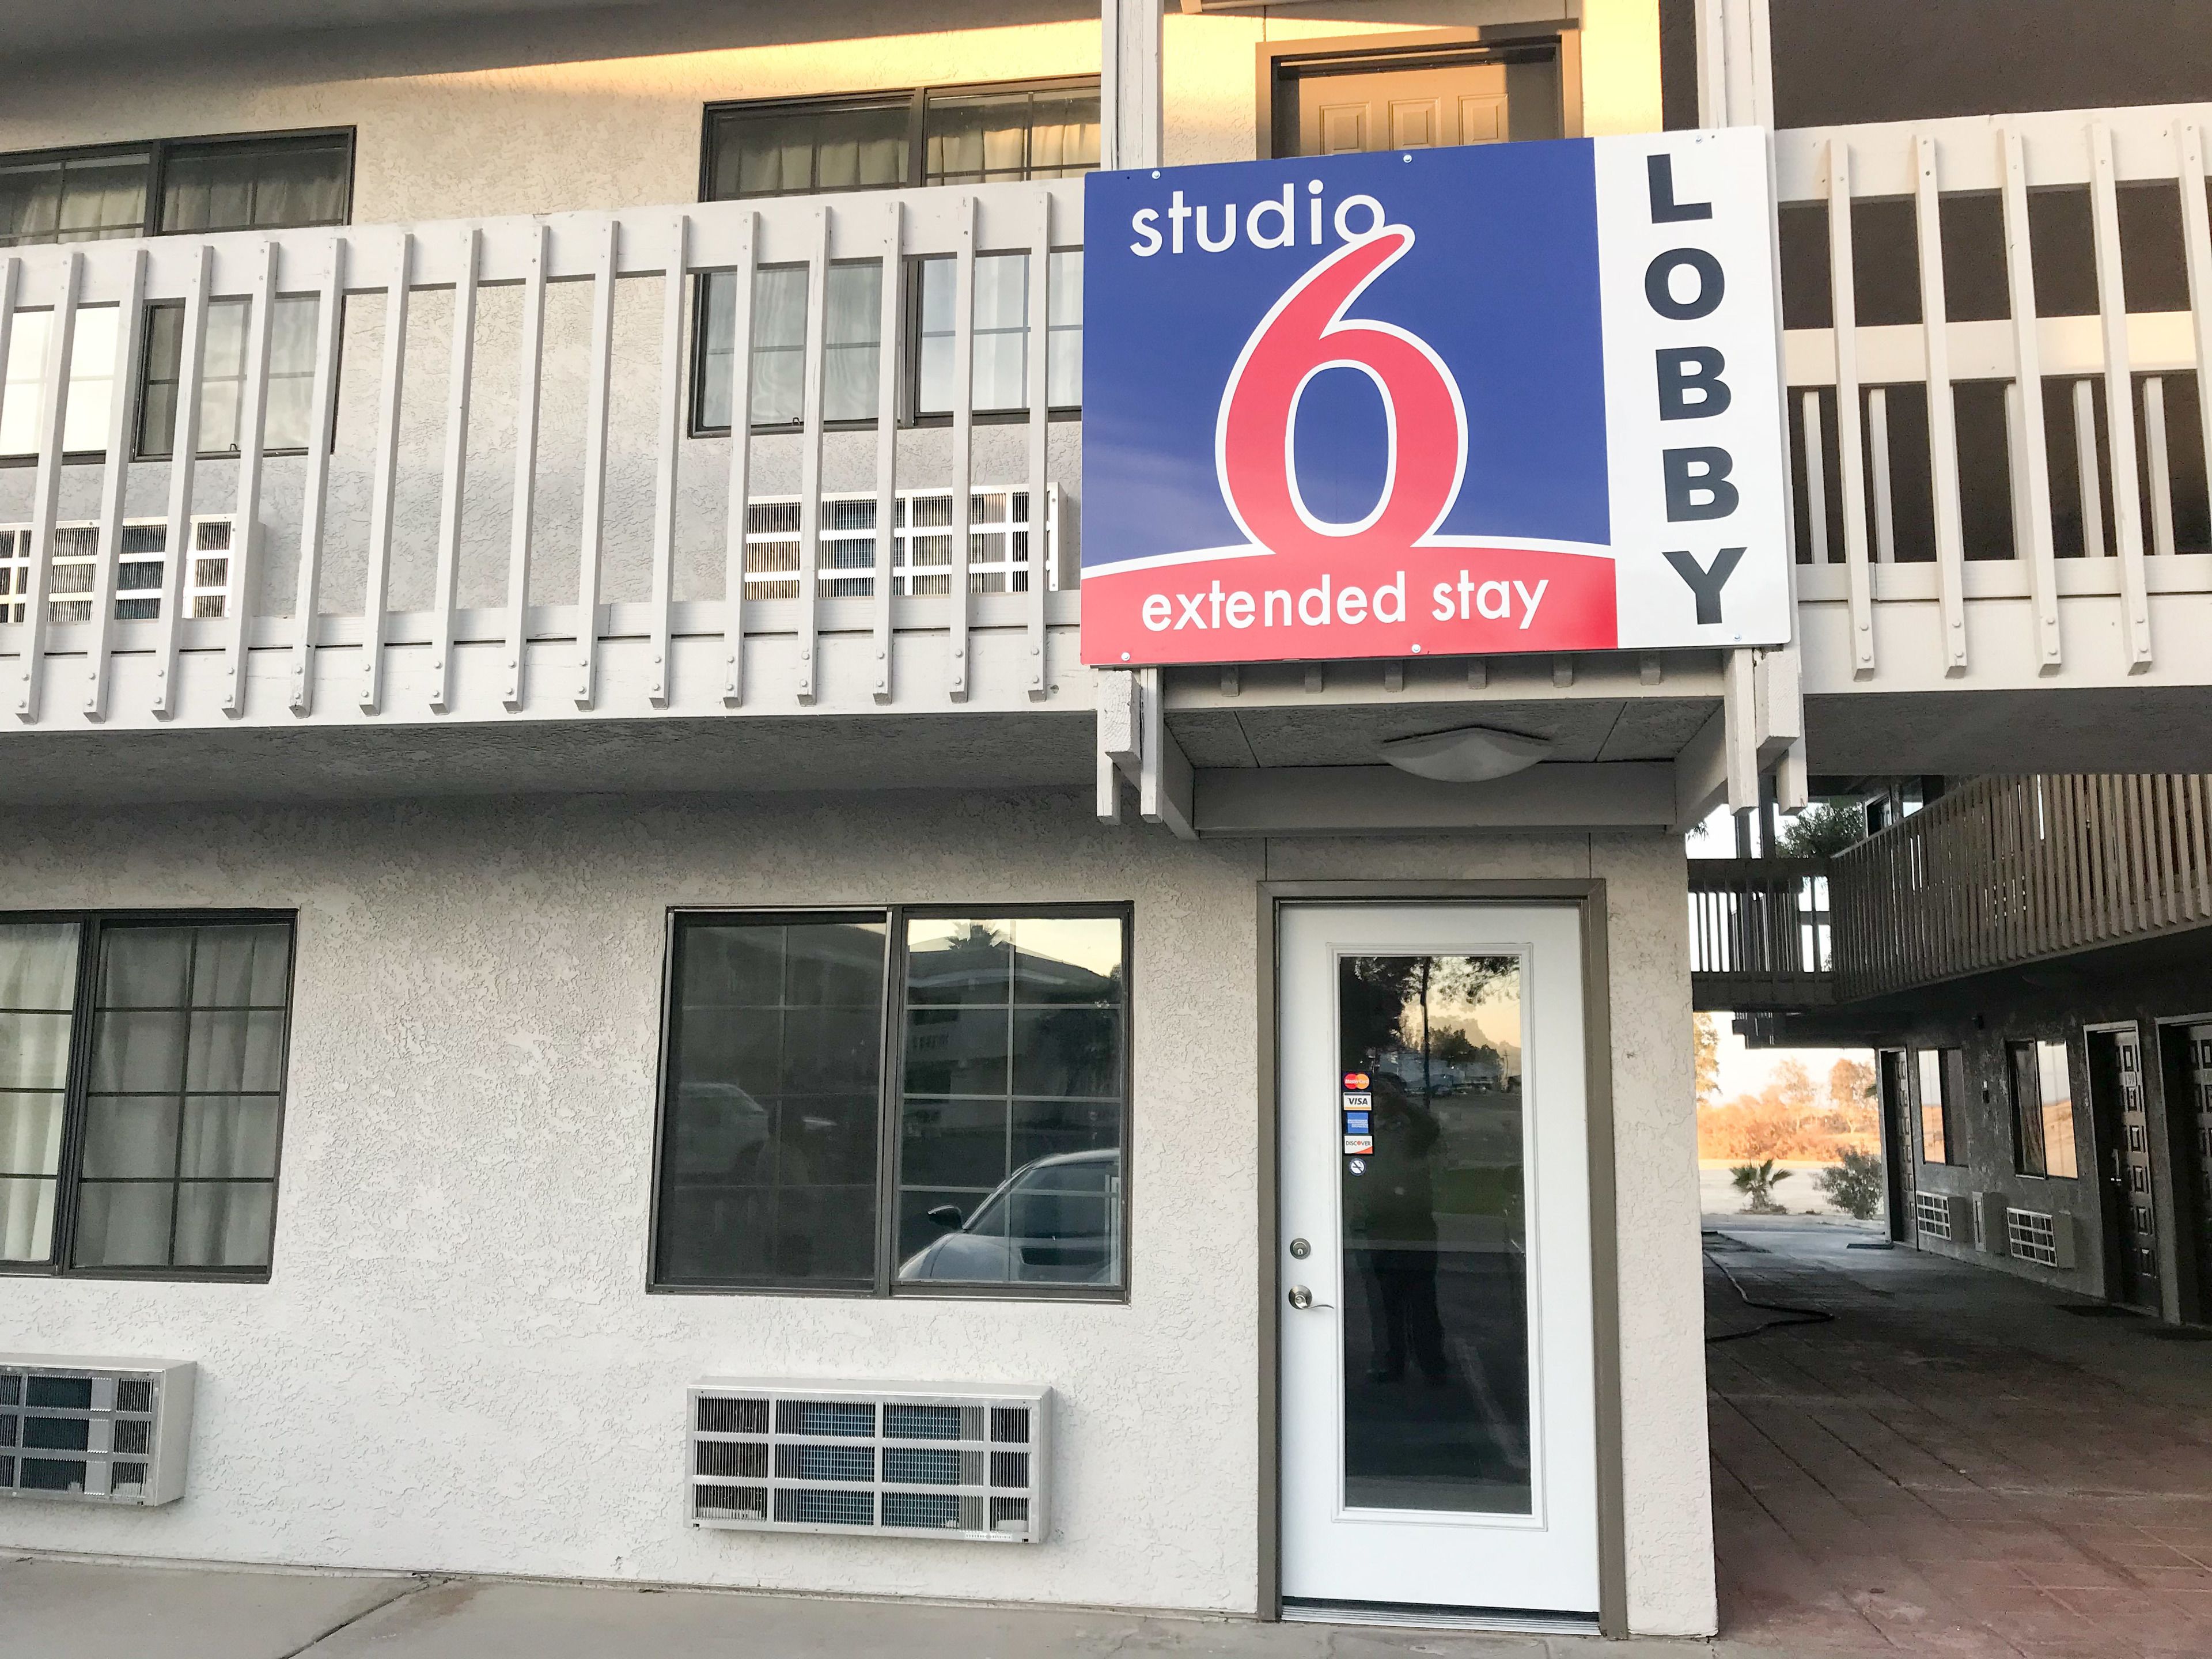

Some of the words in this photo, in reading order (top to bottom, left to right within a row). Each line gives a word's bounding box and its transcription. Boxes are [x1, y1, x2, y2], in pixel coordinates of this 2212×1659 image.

[1130, 179, 1385, 257] studio
[1217, 224, 1468, 554] 6
[1645, 153, 1747, 626] LOBBY
[1142, 570, 1406, 631] extended
[1431, 570, 1550, 630] stay
